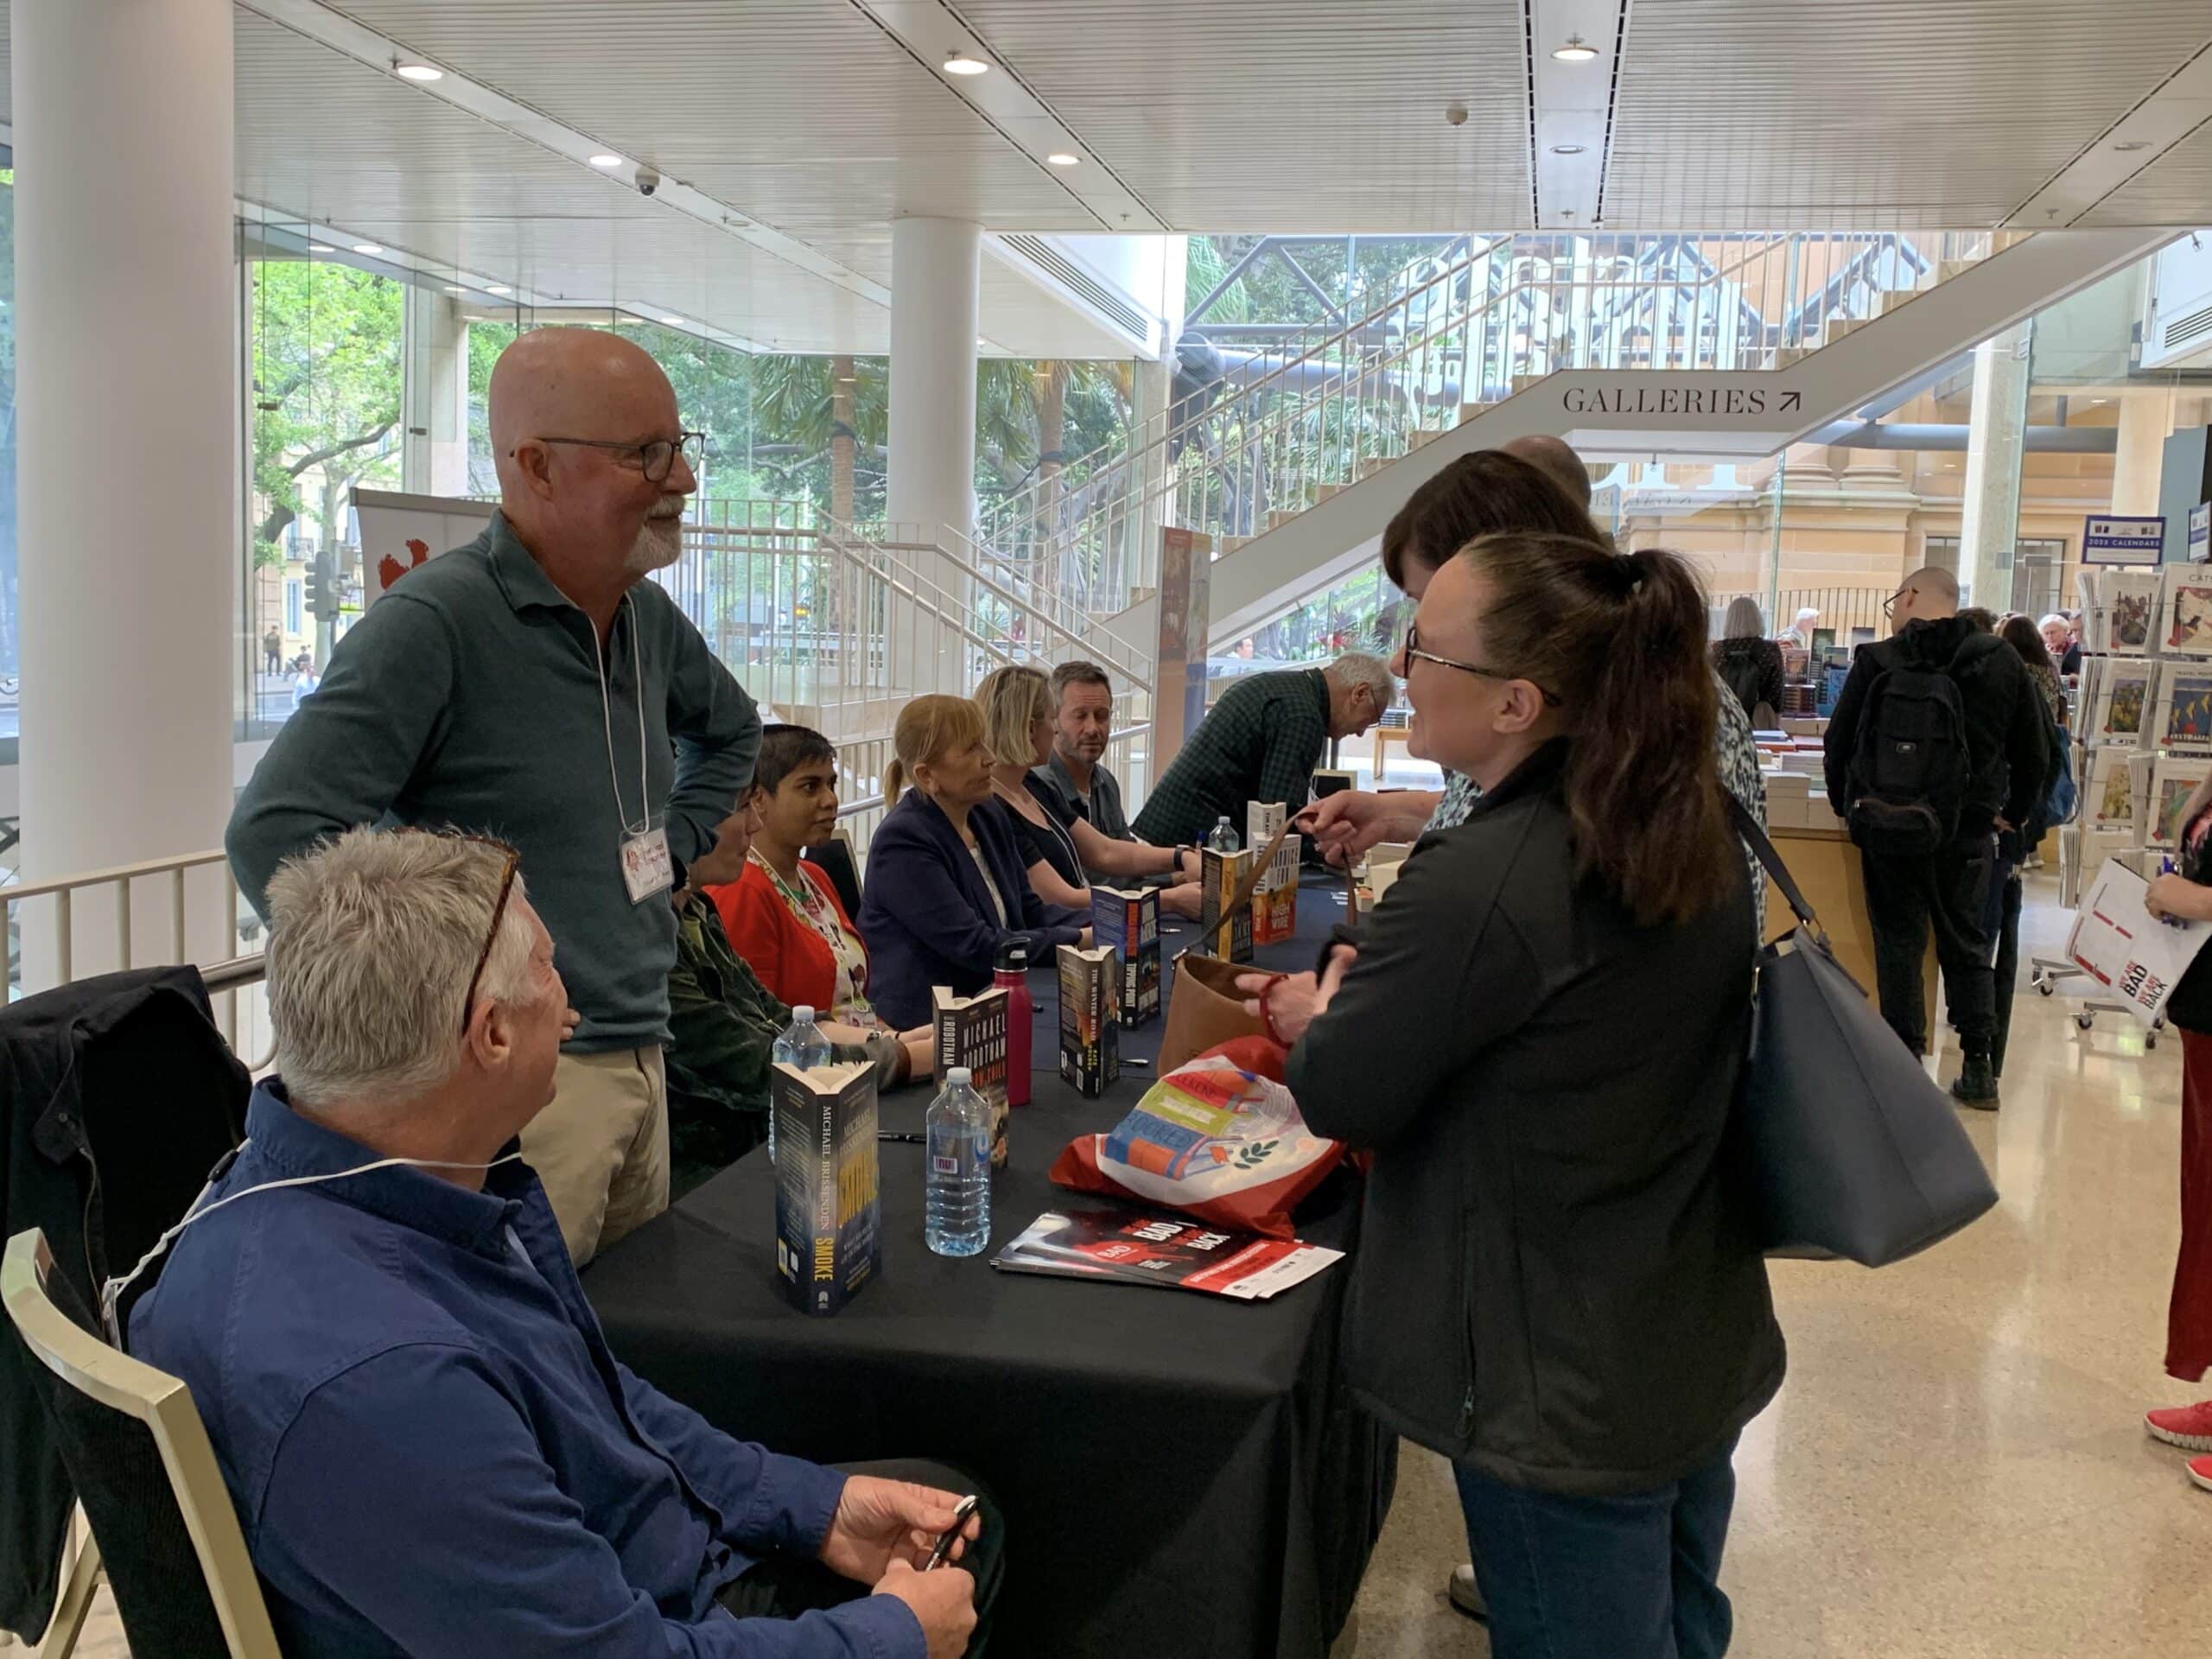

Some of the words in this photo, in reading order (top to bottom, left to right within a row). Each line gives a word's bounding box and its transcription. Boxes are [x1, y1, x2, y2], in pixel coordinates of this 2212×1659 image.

[1563, 388, 1765, 414] GALLERIES
[1126, 963, 1137, 988] TIPPING
[2123, 964, 2148, 998] BAD
[1125, 988, 1136, 1007] POINT
[2143, 979, 2169, 1010] BACK
[943, 1020, 956, 1065] ROBOTHAM
[963, 1012, 1006, 1049] MICHAEL
[963, 1036, 1007, 1071] ROBOTHAM
[823, 1105, 831, 1159] MICHAEL
[821, 1160, 830, 1230] BRISSENDEN
[1132, 1222, 1184, 1242] BAD
[1186, 1231, 1231, 1251] BACK
[814, 1237, 834, 1282] SMOKE
